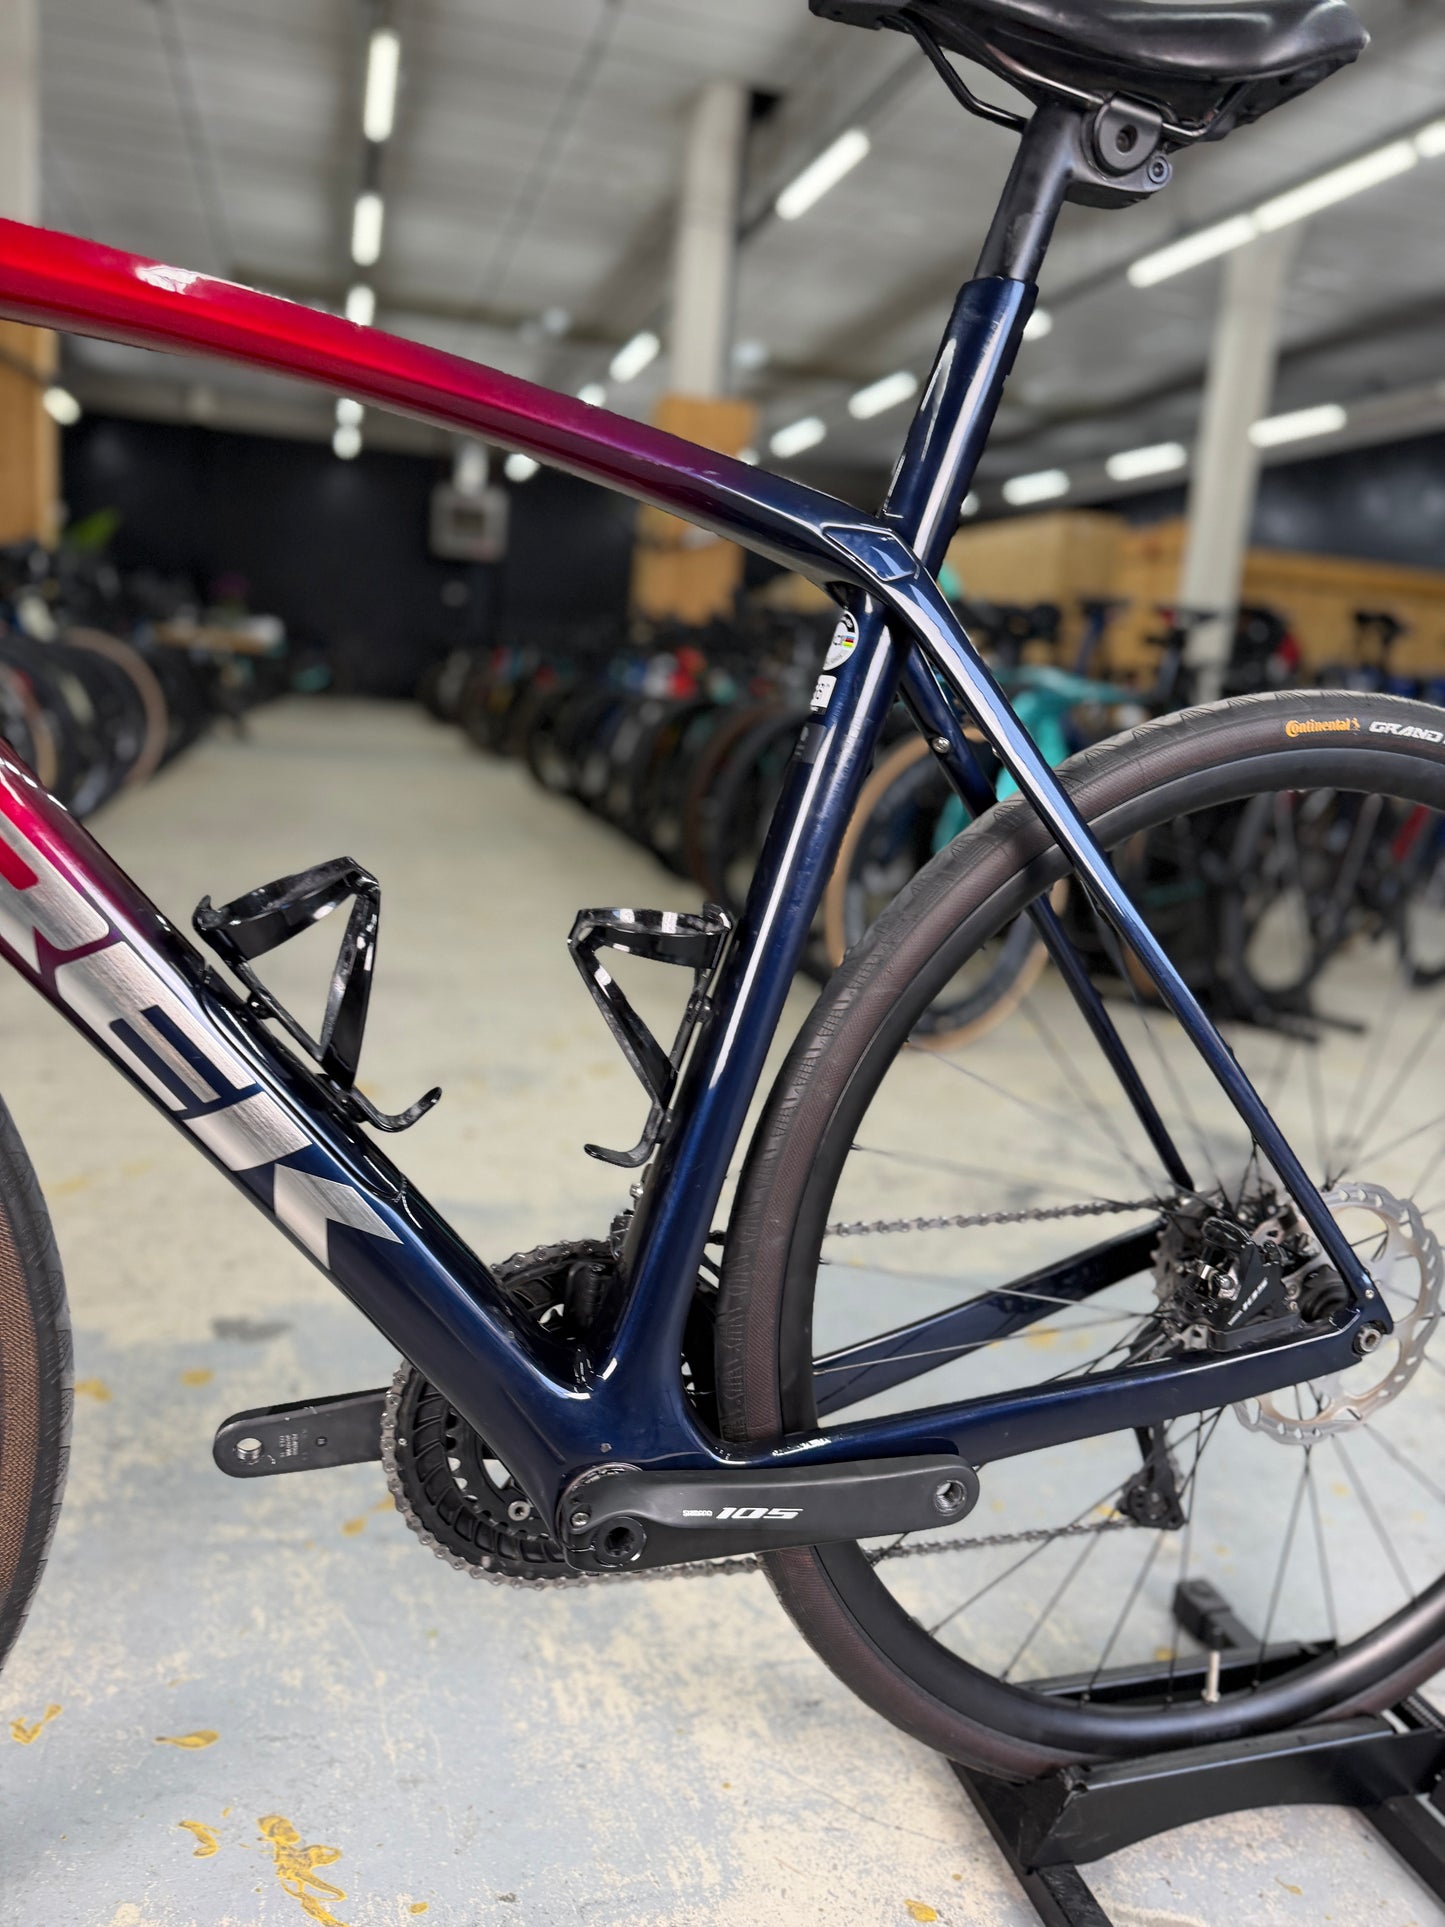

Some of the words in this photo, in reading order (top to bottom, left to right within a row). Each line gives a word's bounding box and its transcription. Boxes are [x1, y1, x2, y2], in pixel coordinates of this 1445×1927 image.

[1285, 717, 1351, 738] Continental
[1369, 721, 1443, 743] GRAND
[716, 1507, 804, 1519] 105
